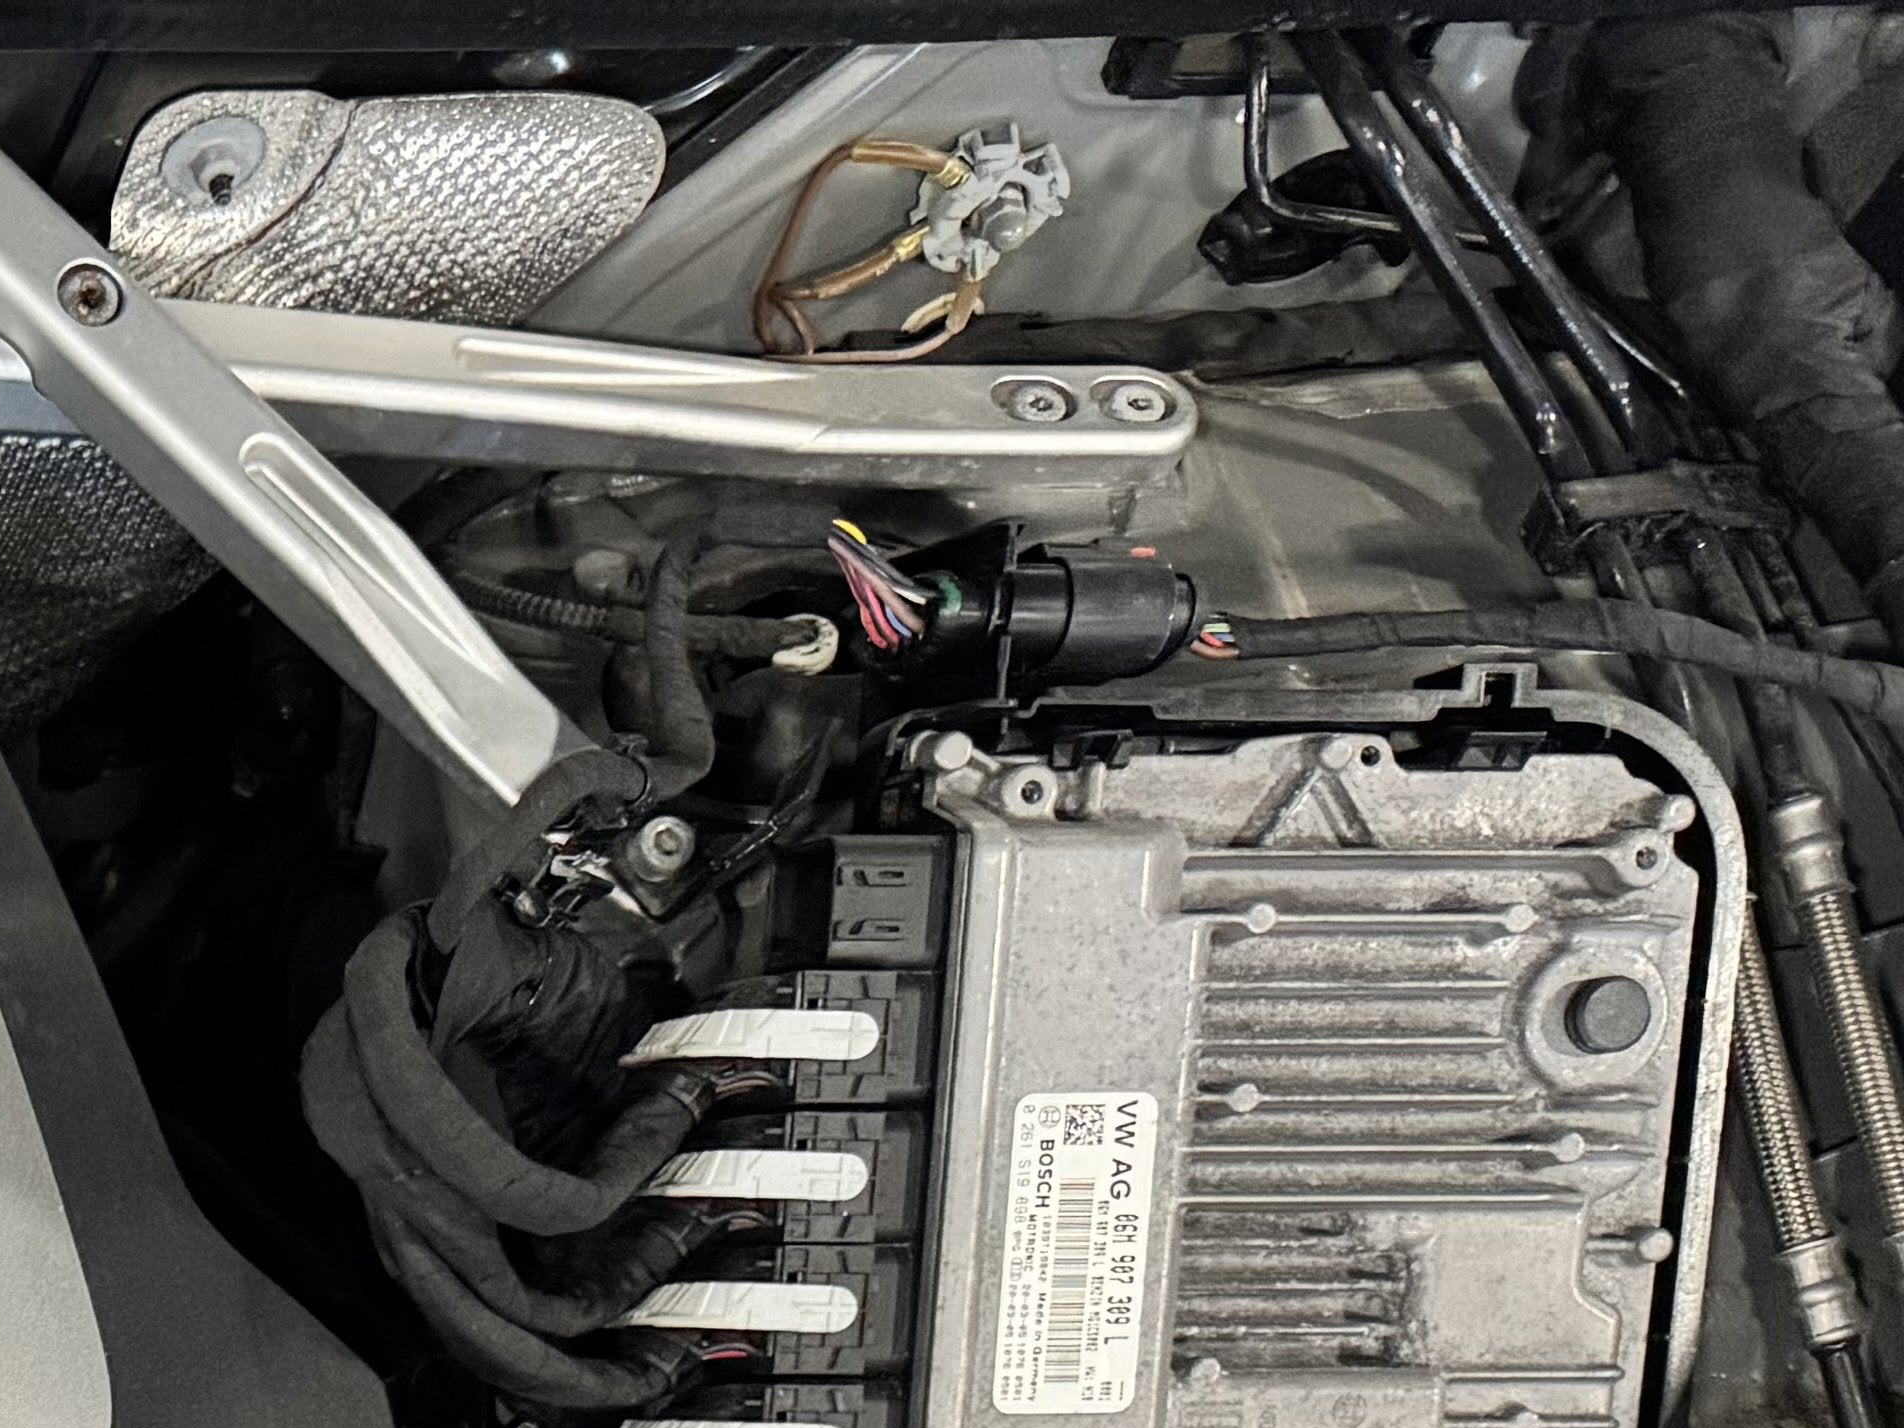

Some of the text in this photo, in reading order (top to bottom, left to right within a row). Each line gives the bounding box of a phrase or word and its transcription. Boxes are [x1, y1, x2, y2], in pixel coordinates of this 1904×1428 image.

[1113, 1099, 1139, 1149] VW
[1034, 1139, 1055, 1208] BOSCH
[1109, 1158, 1133, 1200] AG
[1104, 1334, 1129, 1345] L
